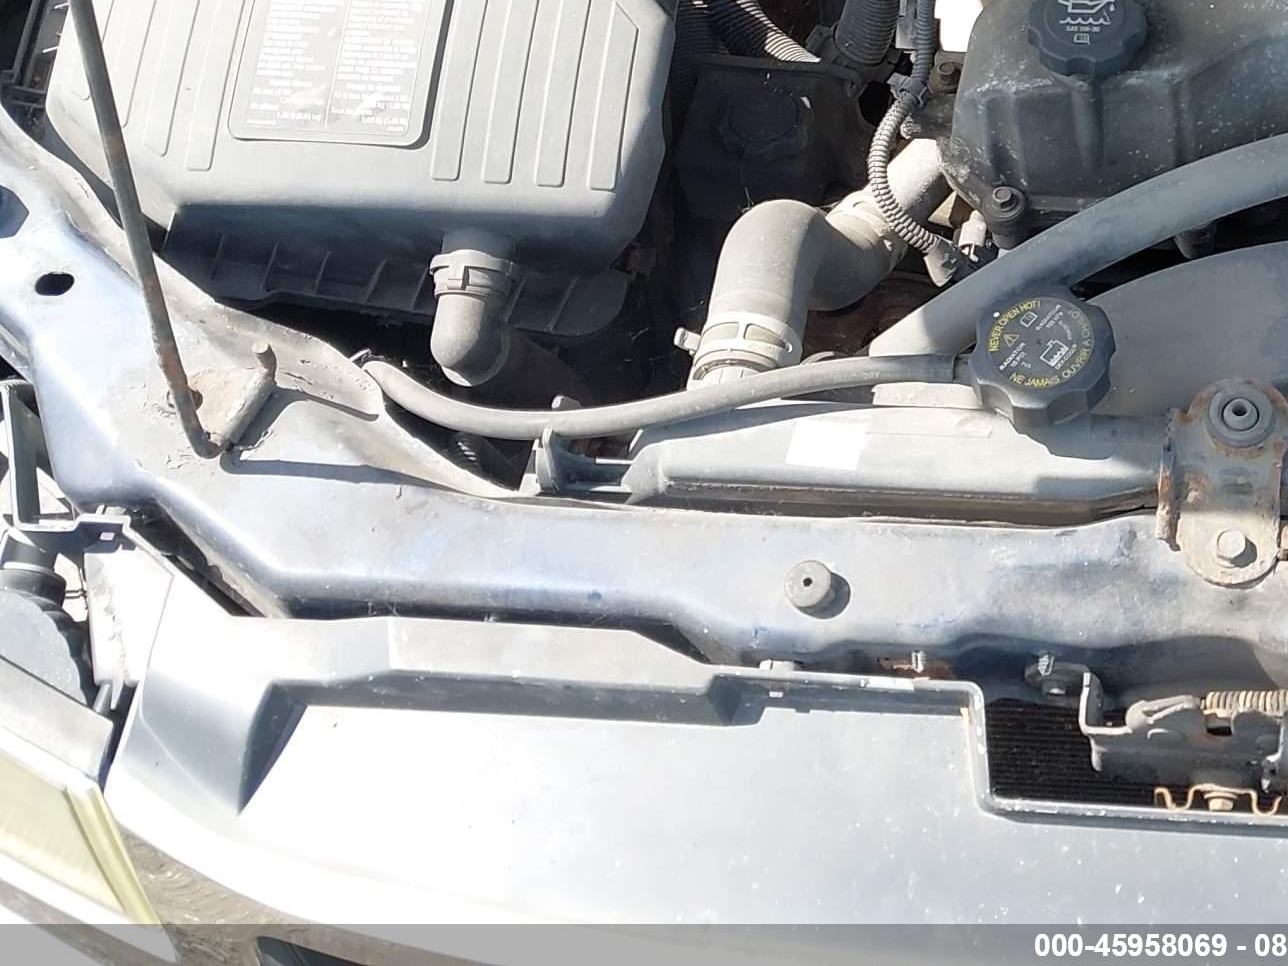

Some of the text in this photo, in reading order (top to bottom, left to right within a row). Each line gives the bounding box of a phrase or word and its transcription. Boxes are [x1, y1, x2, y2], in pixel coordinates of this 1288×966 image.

[989, 300, 1040, 352] NEVER OPEN HOT!
[999, 342, 1026, 370] RADIATOR
[1009, 372, 1025, 384] NE
[1024, 375, 1060, 387] JAMAIS
[1062, 348, 1090, 378] OUVRIR
